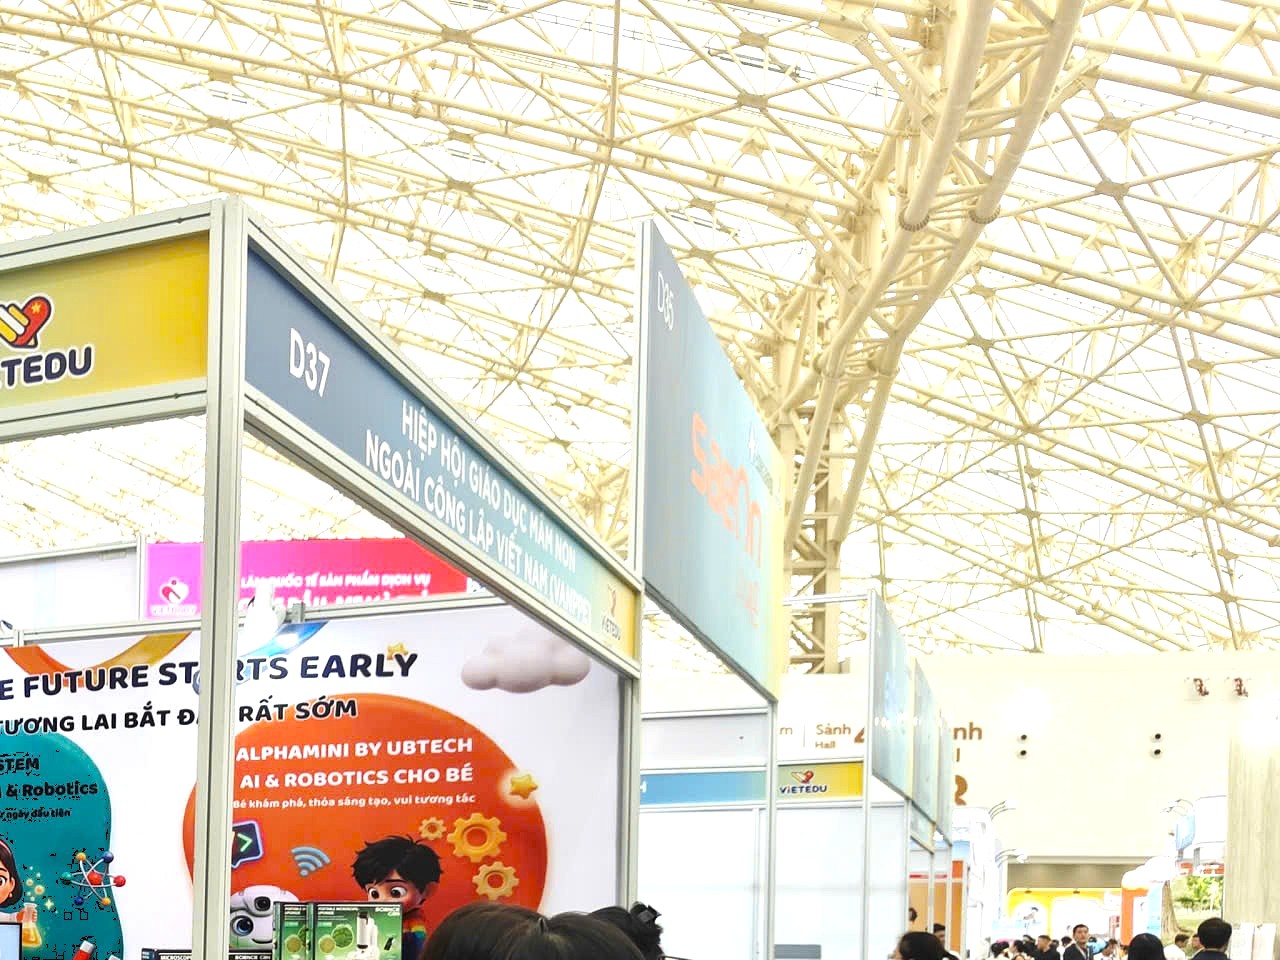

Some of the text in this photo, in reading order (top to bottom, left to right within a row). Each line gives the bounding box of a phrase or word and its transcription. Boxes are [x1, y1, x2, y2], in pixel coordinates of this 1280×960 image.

[289, 328, 330, 397] D37
[402, 399, 576, 573] HIỆP HỘI GIÁO DỤC NON
[365, 429, 420, 502] NGOÀI
[424, 476, 466, 531] CÔNG
[524, 555, 548, 600] NAM
[23, 664, 150, 699] FUTURE
[157, 656, 289, 686] STTS
[300, 653, 417, 679] EARLY
[81, 711, 118, 732] LAI
[124, 700, 171, 728] BẮT
[238, 694, 289, 722] RẤT
[295, 696, 358, 720] SỚM
[235, 738, 473, 761] ALPHAMINI BY UBTECH
[6, 783, 19, 798] &
[22, 780, 99, 798] Robotics
[240, 762, 473, 789] AI & ROBOTICS CHO BÉ
[249, 798, 280, 809] khám
[282, 797, 307, 809] phá,
[334, 796, 367, 808] sáng
[393, 795, 413, 805] vui
[414, 794, 454, 807] tương
[455, 792, 476, 804] tác
